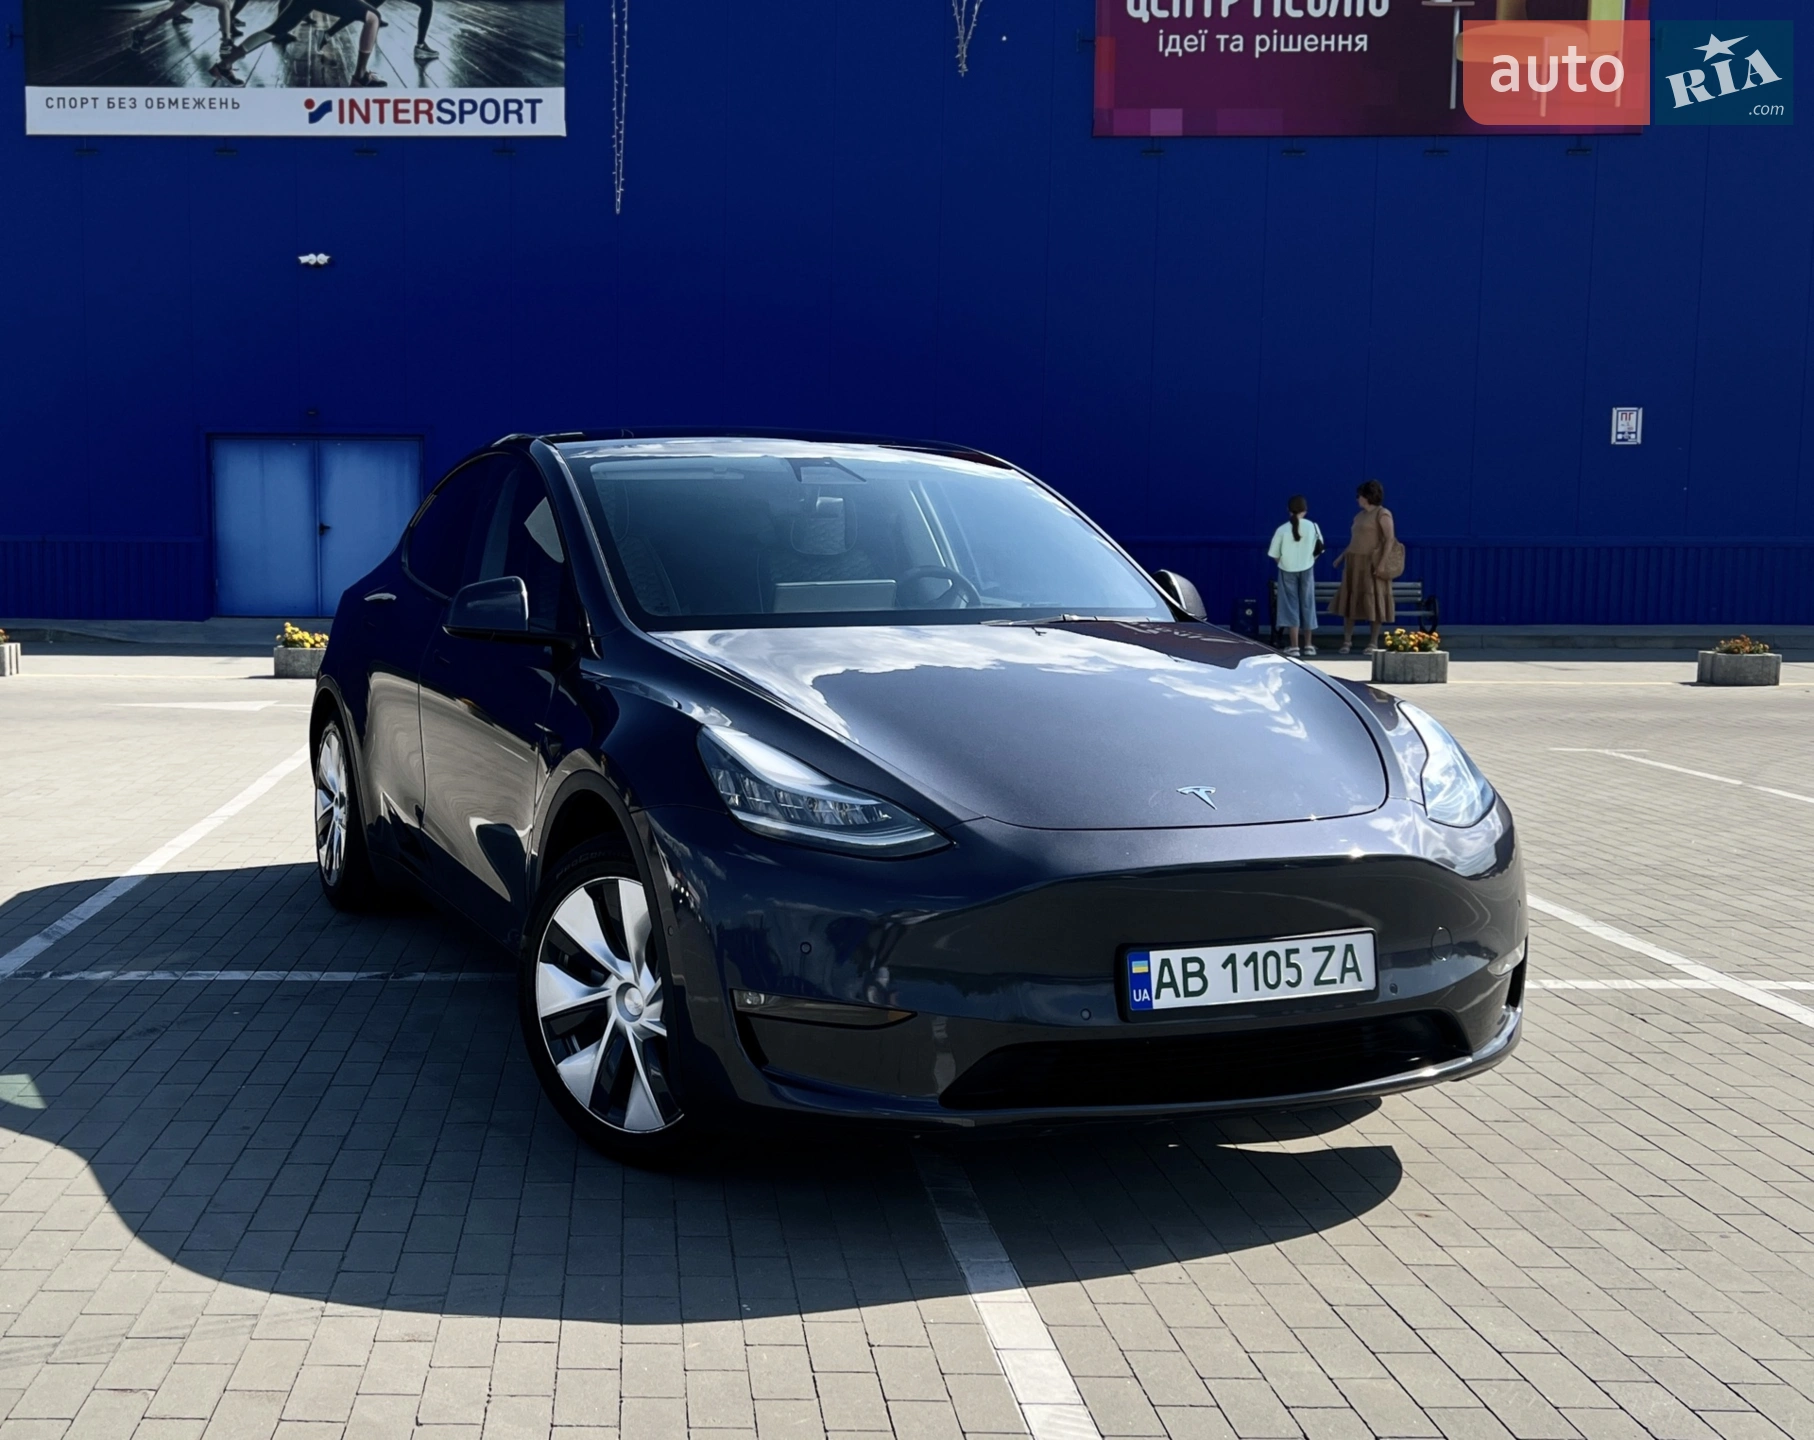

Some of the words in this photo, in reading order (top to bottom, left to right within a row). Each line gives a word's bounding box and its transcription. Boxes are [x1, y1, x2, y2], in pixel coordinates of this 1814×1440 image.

[1157, 29, 1208, 58] ідеї
[1215, 34, 1245, 53] та
[1254, 29, 1369, 59] рішення
[45, 97, 100, 110] СПОРТ
[106, 97, 138, 110] БЕЗ
[144, 97, 241, 110] ОБМЕЖЕНЬ
[337, 97, 544, 125] INTERSPORT
[1154, 956, 1209, 1000] AB
[1221, 947, 1303, 994] 1105
[1311, 943, 1363, 986] ZA
[1132, 988, 1151, 1002] UA
